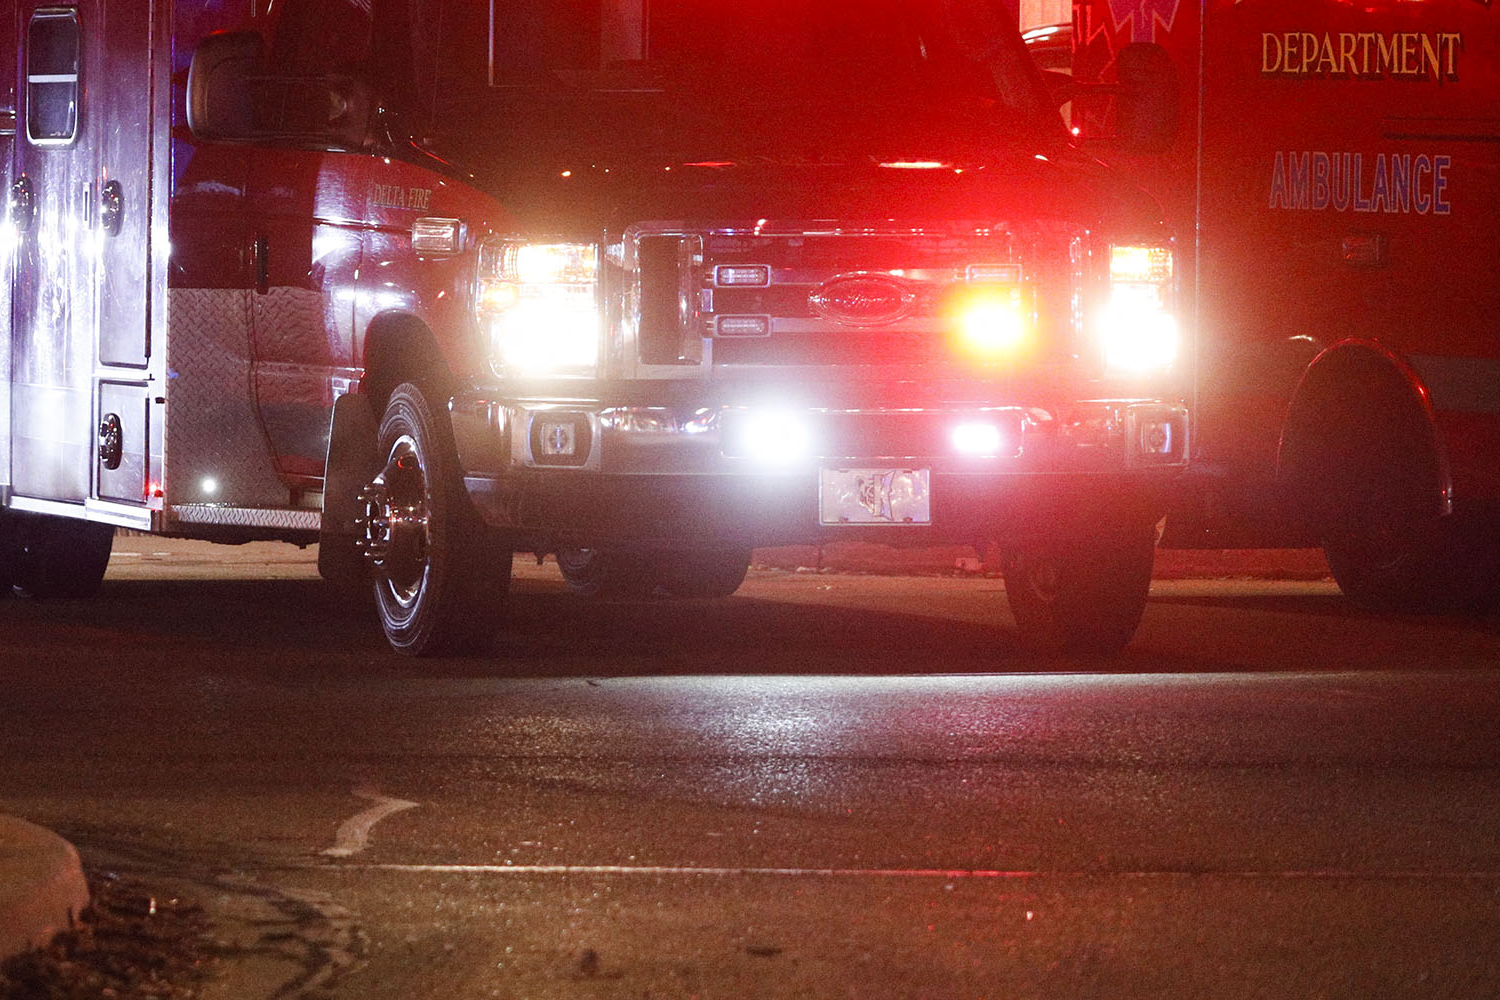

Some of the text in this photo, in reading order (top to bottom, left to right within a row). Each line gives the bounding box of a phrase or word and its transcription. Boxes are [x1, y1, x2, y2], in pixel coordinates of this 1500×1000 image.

[1261, 31, 1462, 81] DEPARTMENT
[373, 184, 432, 210] DELTA FIRE
[1269, 151, 1451, 215] AMBULANCE
